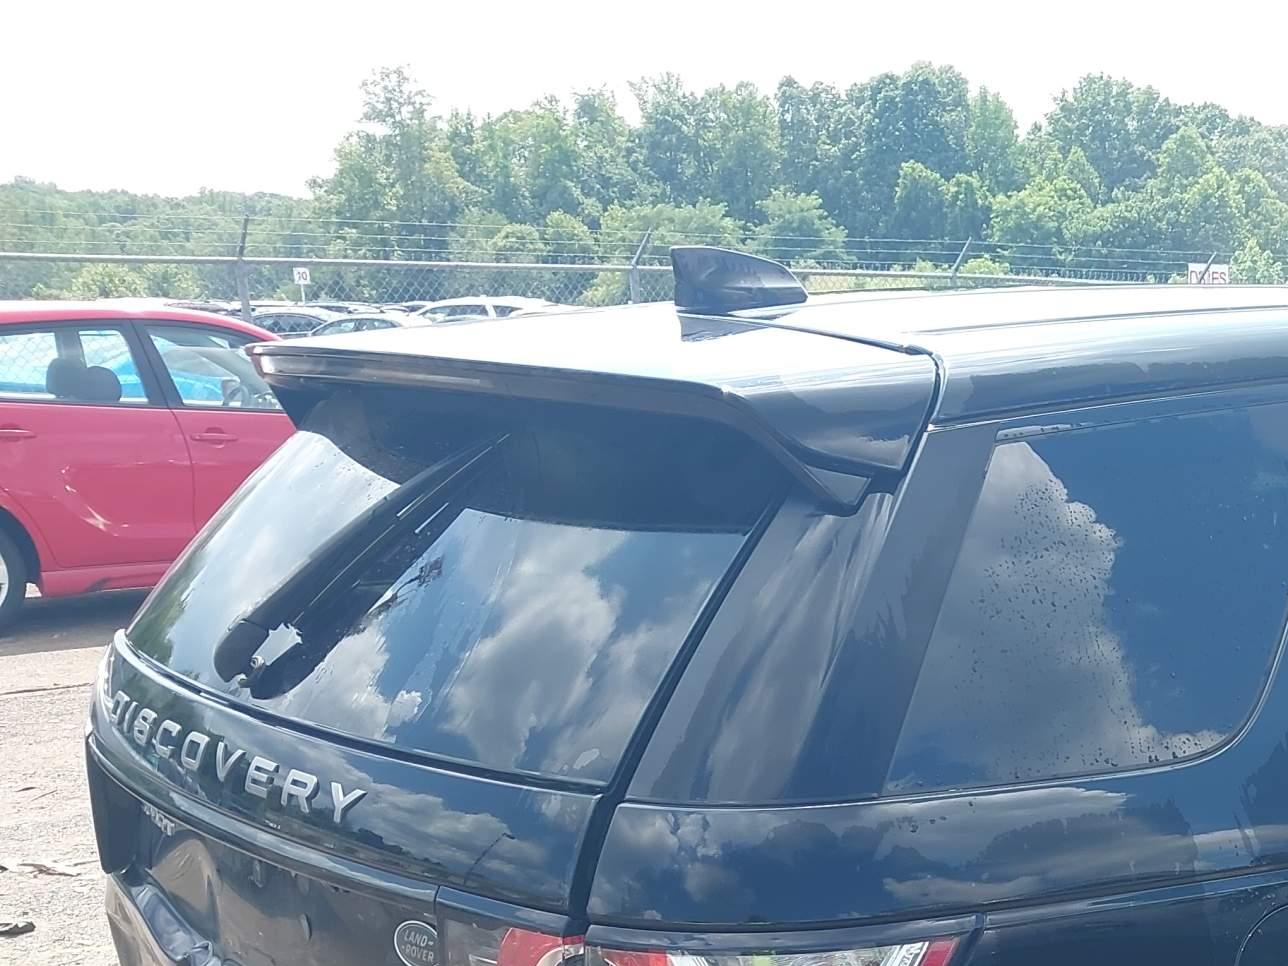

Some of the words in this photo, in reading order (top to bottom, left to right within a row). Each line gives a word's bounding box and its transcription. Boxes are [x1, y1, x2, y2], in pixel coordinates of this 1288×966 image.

[108, 689, 367, 824] DISCOVERY
[403, 930, 428, 947] LAND
[405, 944, 434, 962] ROVER
